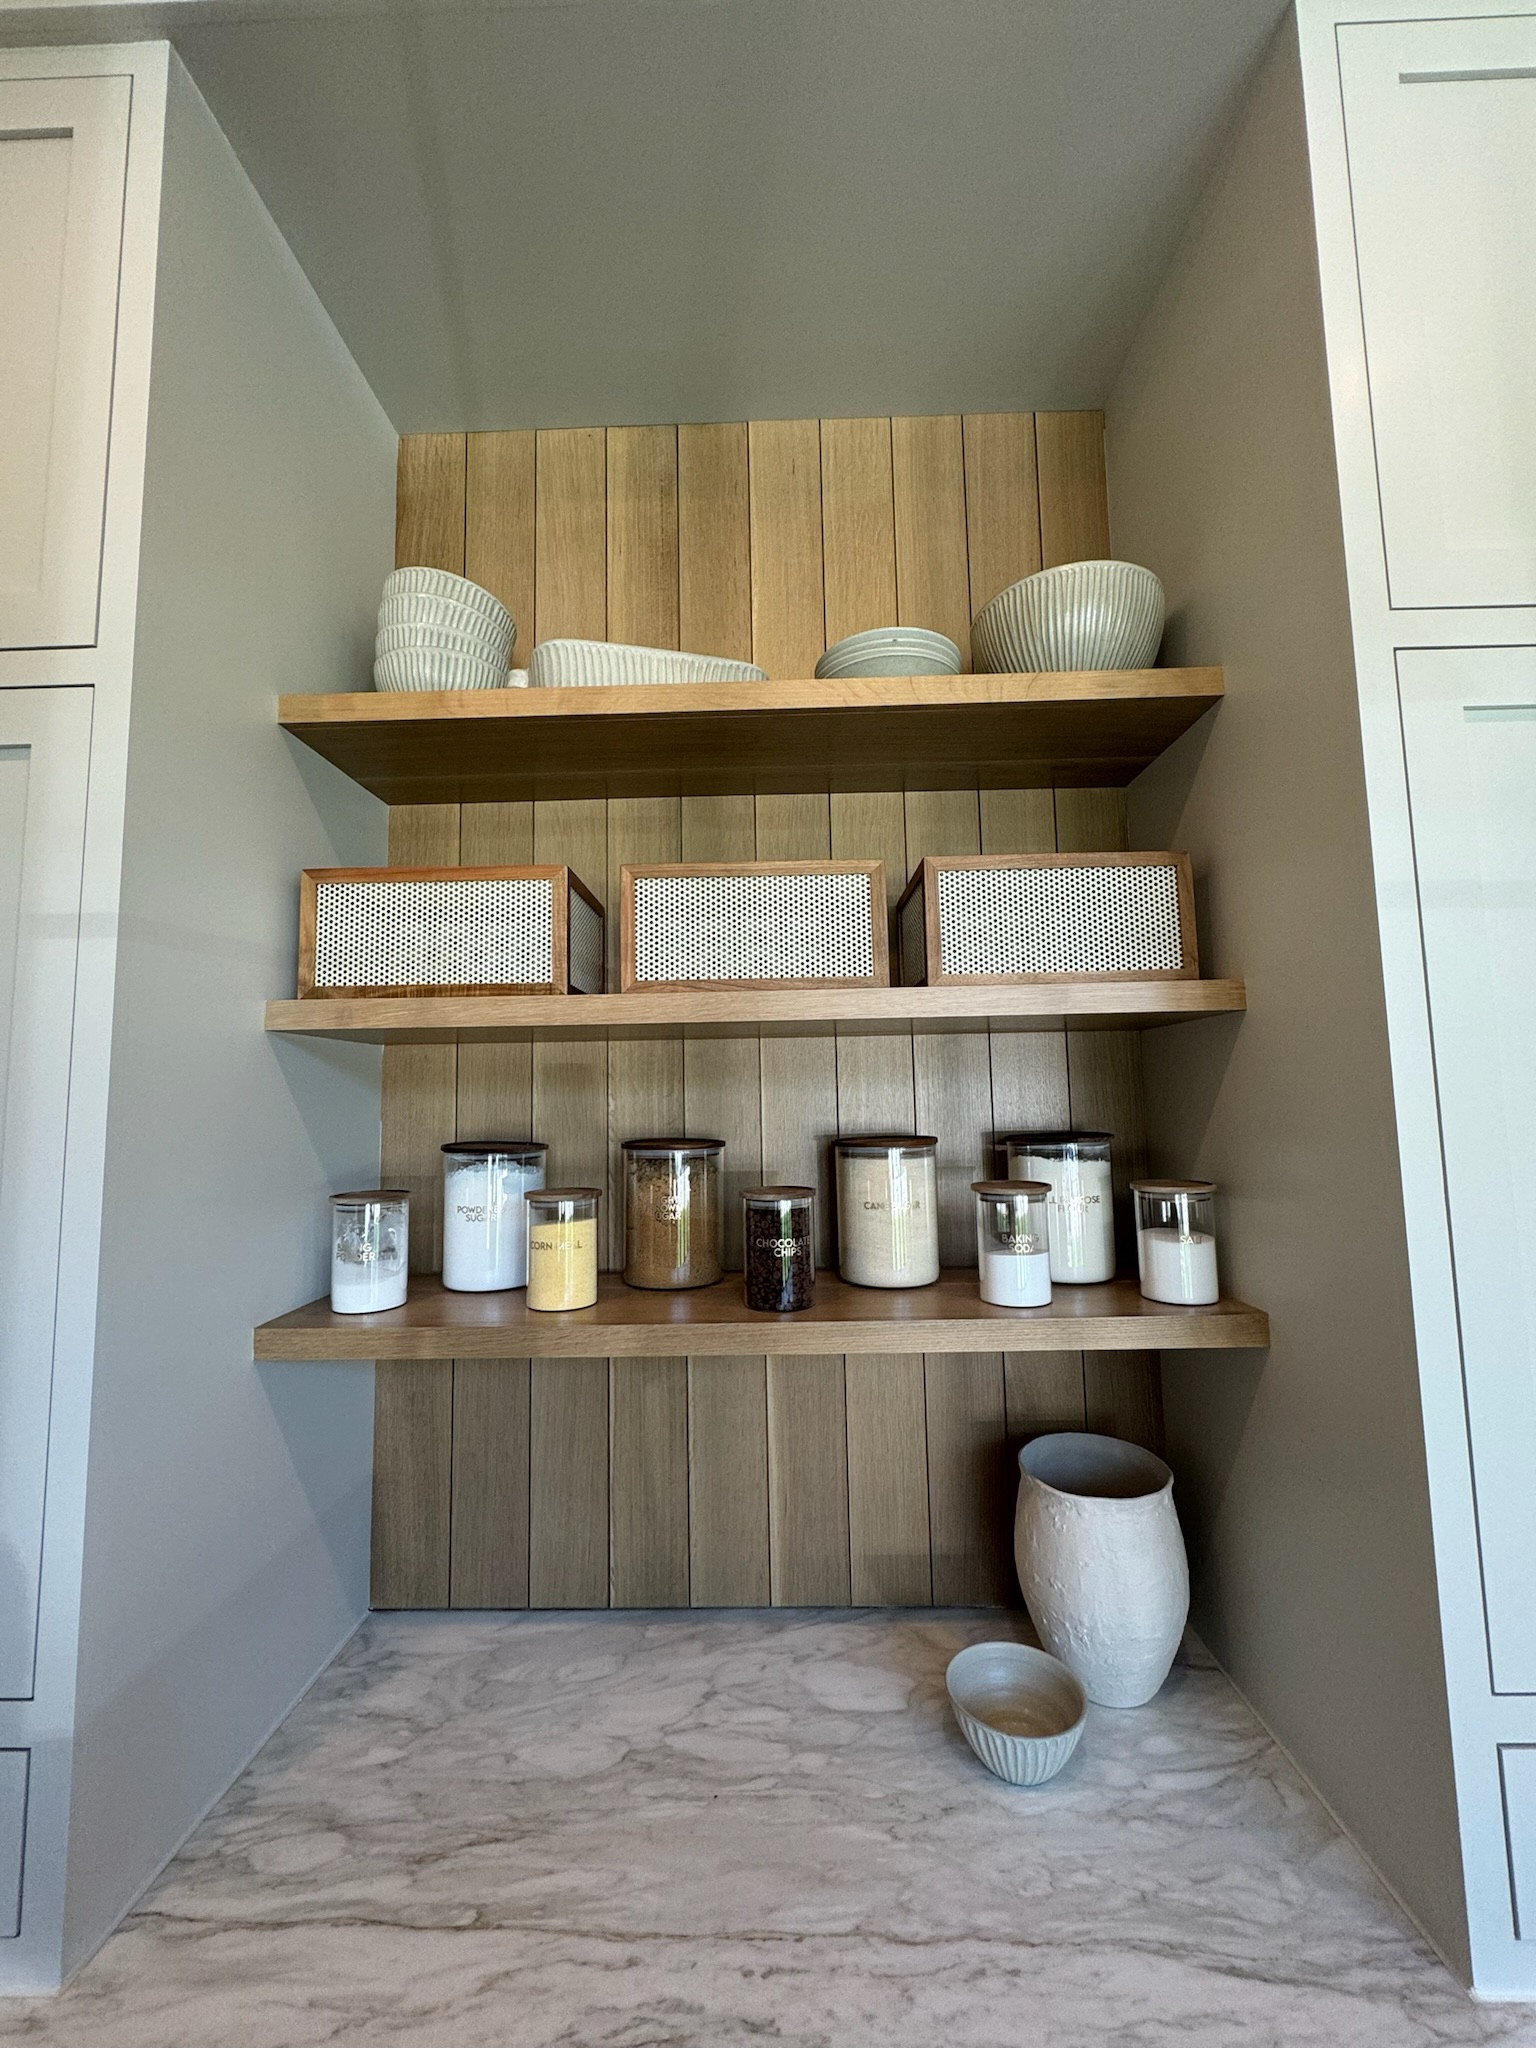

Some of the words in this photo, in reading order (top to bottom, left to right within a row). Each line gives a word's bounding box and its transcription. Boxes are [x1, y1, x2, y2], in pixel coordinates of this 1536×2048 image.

[1060, 1195, 1100, 1204] POSE
[465, 1213, 498, 1222] SUGR
[654, 1211, 682, 1220] UGAR
[756, 1236, 810, 1248] CHOCOLATE
[1001, 1233, 1040, 1244] BAKING
[530, 1240, 553, 1250] CORN
[555, 1240, 583, 1249] MEL
[336, 1252, 376, 1262] PODER
[773, 1247, 802, 1257] CHIPS
